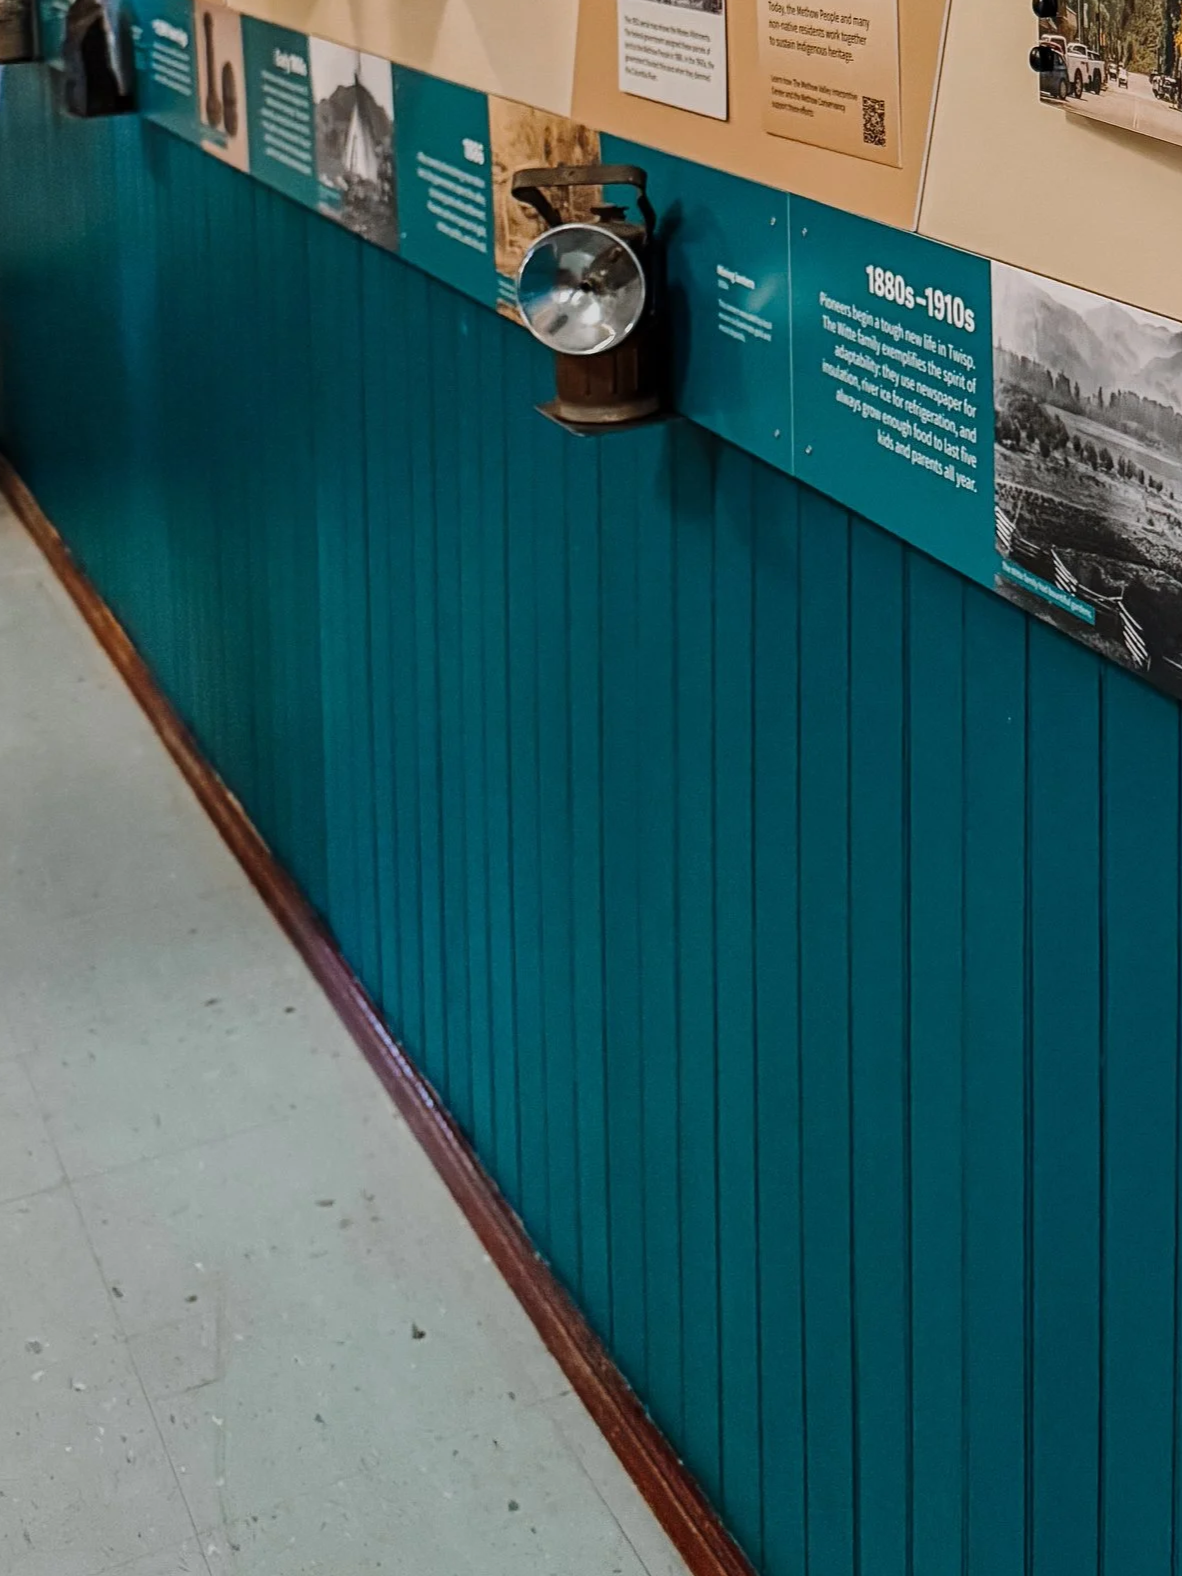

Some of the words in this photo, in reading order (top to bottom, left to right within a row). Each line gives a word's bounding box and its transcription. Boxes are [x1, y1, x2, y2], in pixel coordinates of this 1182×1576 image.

[786, 4, 796, 16] the
[841, 13, 852, 25] and
[819, 291, 851, 318] Pioneers
[852, 304, 873, 329] begin
[874, 317, 880, 329] a
[881, 317, 904, 342] tough
[905, 330, 923, 347] new
[923, 333, 937, 353] life
[938, 339, 947, 358] in
[948, 343, 976, 371] Twisp.
[822, 315, 837, 333] The
[857, 328, 881, 355] family
[881, 343, 927, 373] exemplifies
[928, 360, 942, 379] the
[943, 369, 966, 391] spirit
[966, 377, 977, 394] of
[861, 377, 879, 397] river
[880, 384, 892, 403] ice
[892, 390, 904, 409] for
[904, 399, 958, 437] refrigeration,
[959, 425, 977, 443] and
[882, 364, 900, 387] they
[900, 375, 915, 391] use
[916, 381, 963, 411] newspaper
[963, 398, 977, 418] for
[836, 388, 861, 412] always
[862, 402, 881, 419] grow
[882, 412, 912, 438] enough
[913, 423, 933, 446] food
[933, 434, 943, 452] to
[944, 437, 960, 460] last
[960, 446, 977, 468] five
[877, 428, 894, 451] kids
[895, 442, 911, 459] and
[911, 450, 943, 475] parents
[943, 464, 955, 482] all
[956, 472, 977, 493] year.
